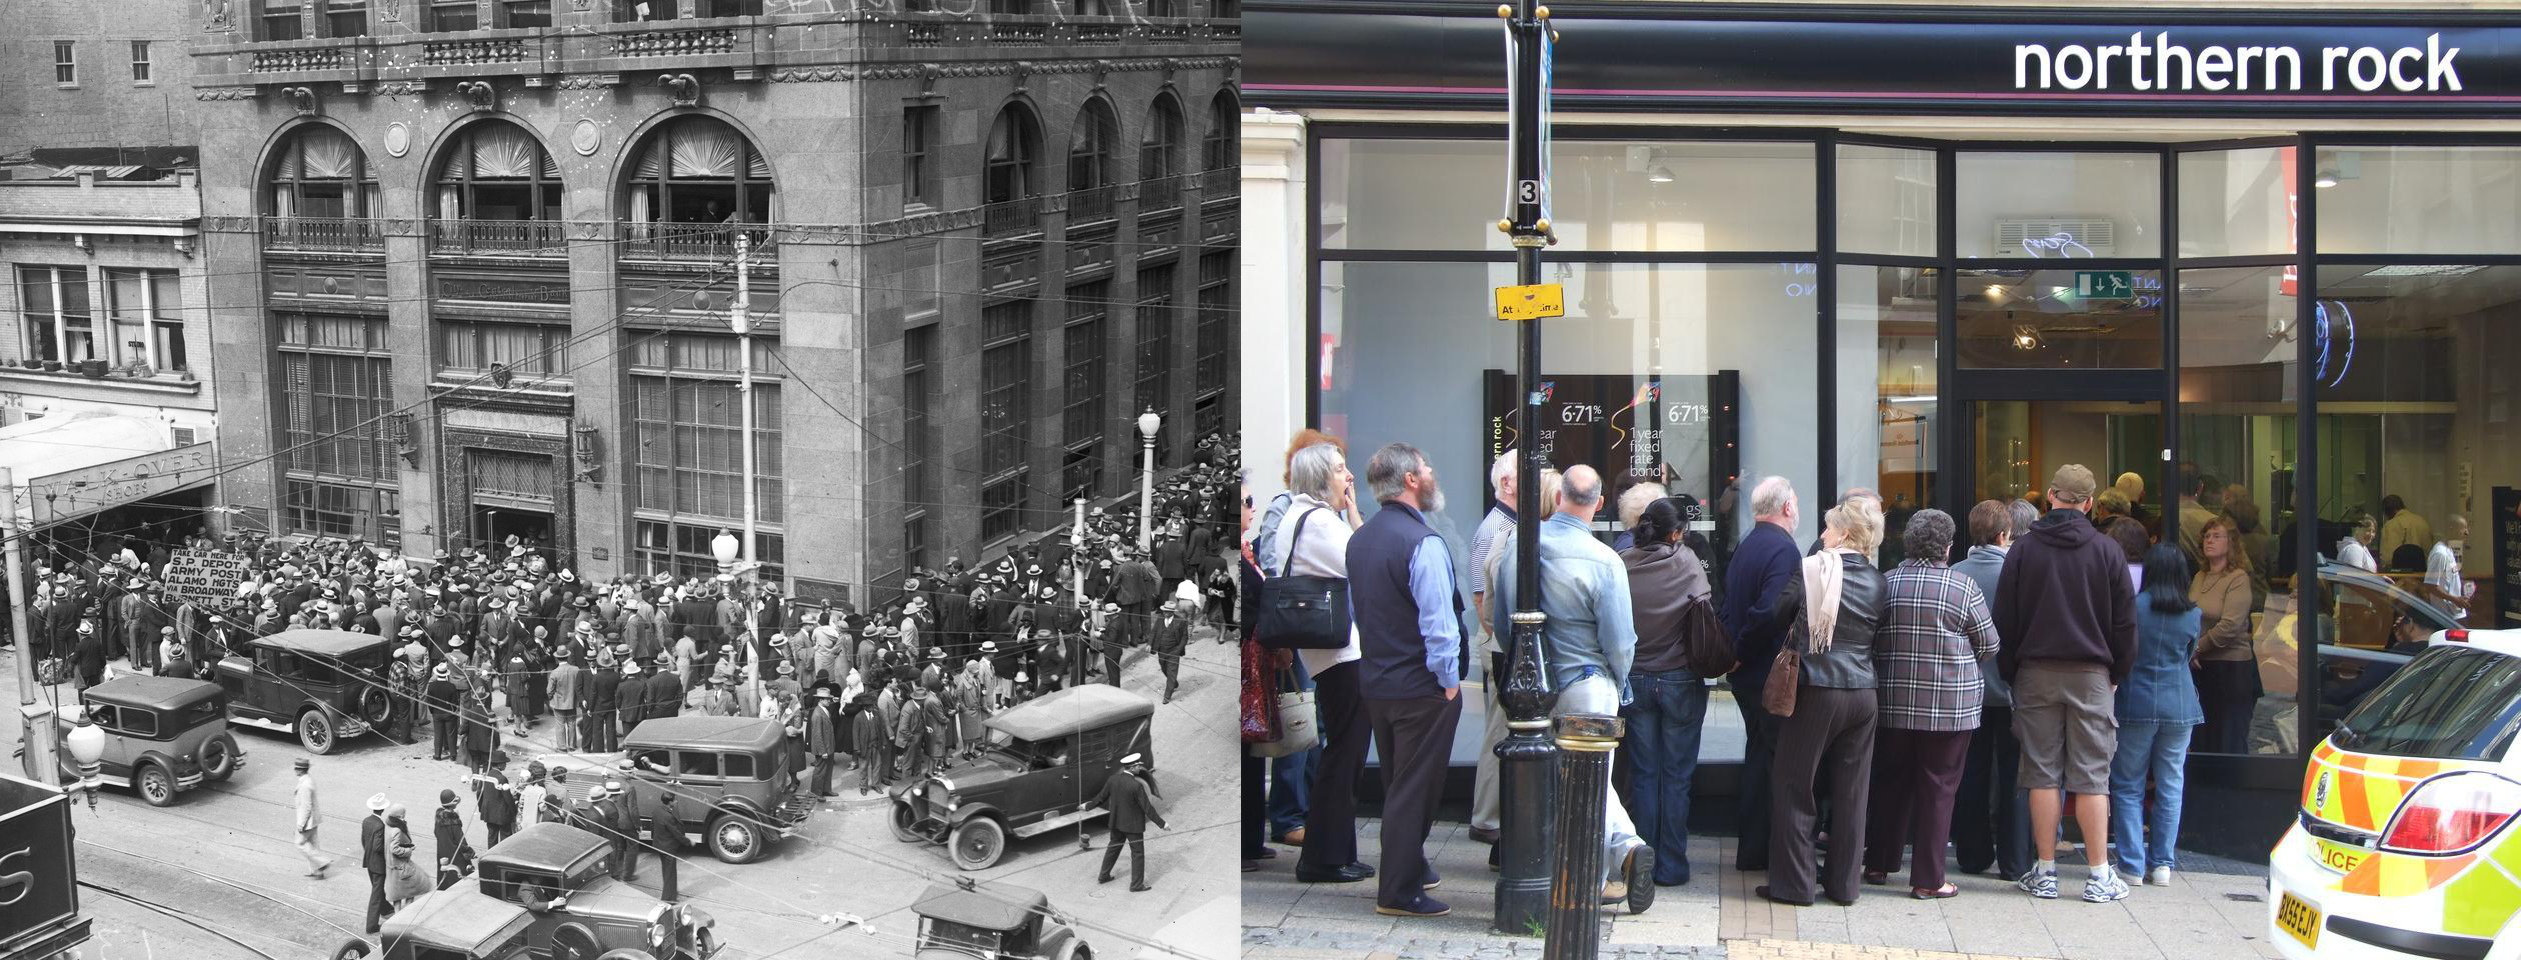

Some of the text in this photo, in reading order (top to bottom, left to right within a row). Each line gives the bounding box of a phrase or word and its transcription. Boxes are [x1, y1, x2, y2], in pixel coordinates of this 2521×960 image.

[2015, 30, 2463, 92] northern rock
[1521, 181, 1536, 203] 3
[1502, 305, 1513, 314] At
[1493, 416, 1502, 440] rock
[1637, 430, 1663, 443] year
[1630, 440, 1660, 452] fixed
[1630, 454, 1654, 465] rate
[44, 451, 204, 496] WALK-OVER
[1630, 464, 1661, 477] bond
[106, 481, 148, 501] SHOES
[173, 549, 191, 557] TAKE
[194, 550, 207, 558] CAR
[211, 552, 228, 560] HERE
[202, 559, 241, 569] DEPOT.
[170, 567, 204, 576] ARMY
[168, 576, 207, 585] ALAMO
[0, 846, 34, 906] S
[2297, 905, 2318, 940] EJY
